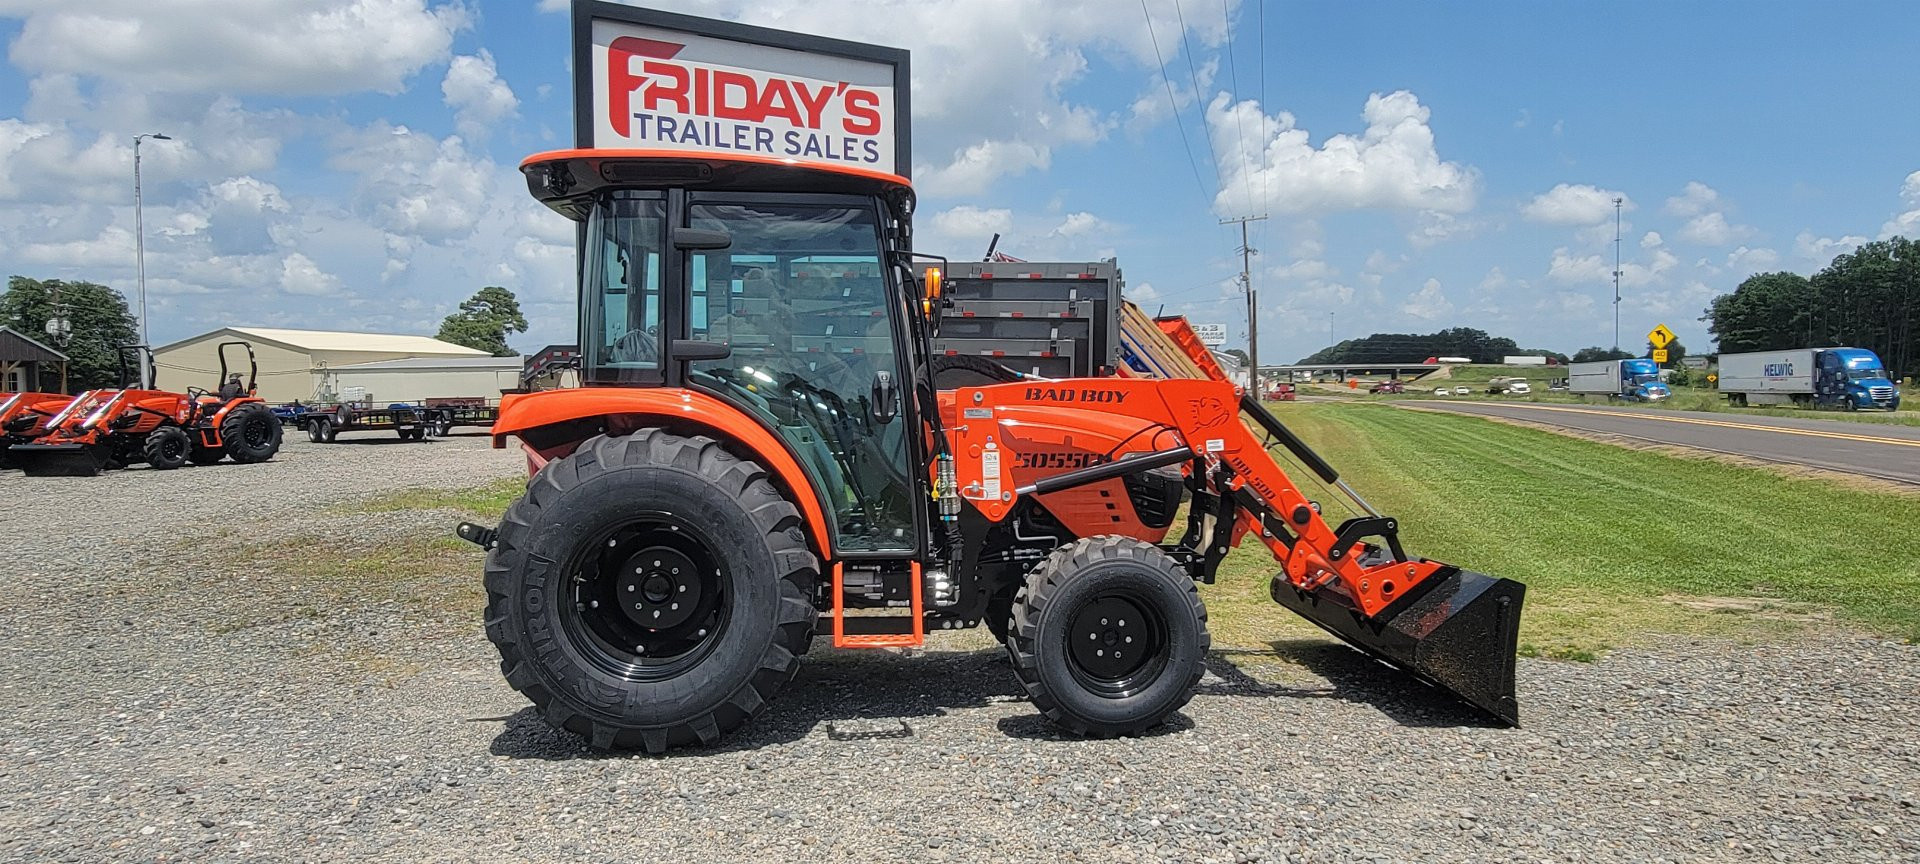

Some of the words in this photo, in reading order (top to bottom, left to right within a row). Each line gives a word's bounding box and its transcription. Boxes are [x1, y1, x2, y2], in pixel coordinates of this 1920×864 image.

[607, 35, 881, 138] FRIDAY'S
[633, 112, 774, 153] TRAILER
[784, 130, 880, 163] SALES
[1025, 387, 1075, 402] BAD
[1080, 389, 1129, 403] BOY
